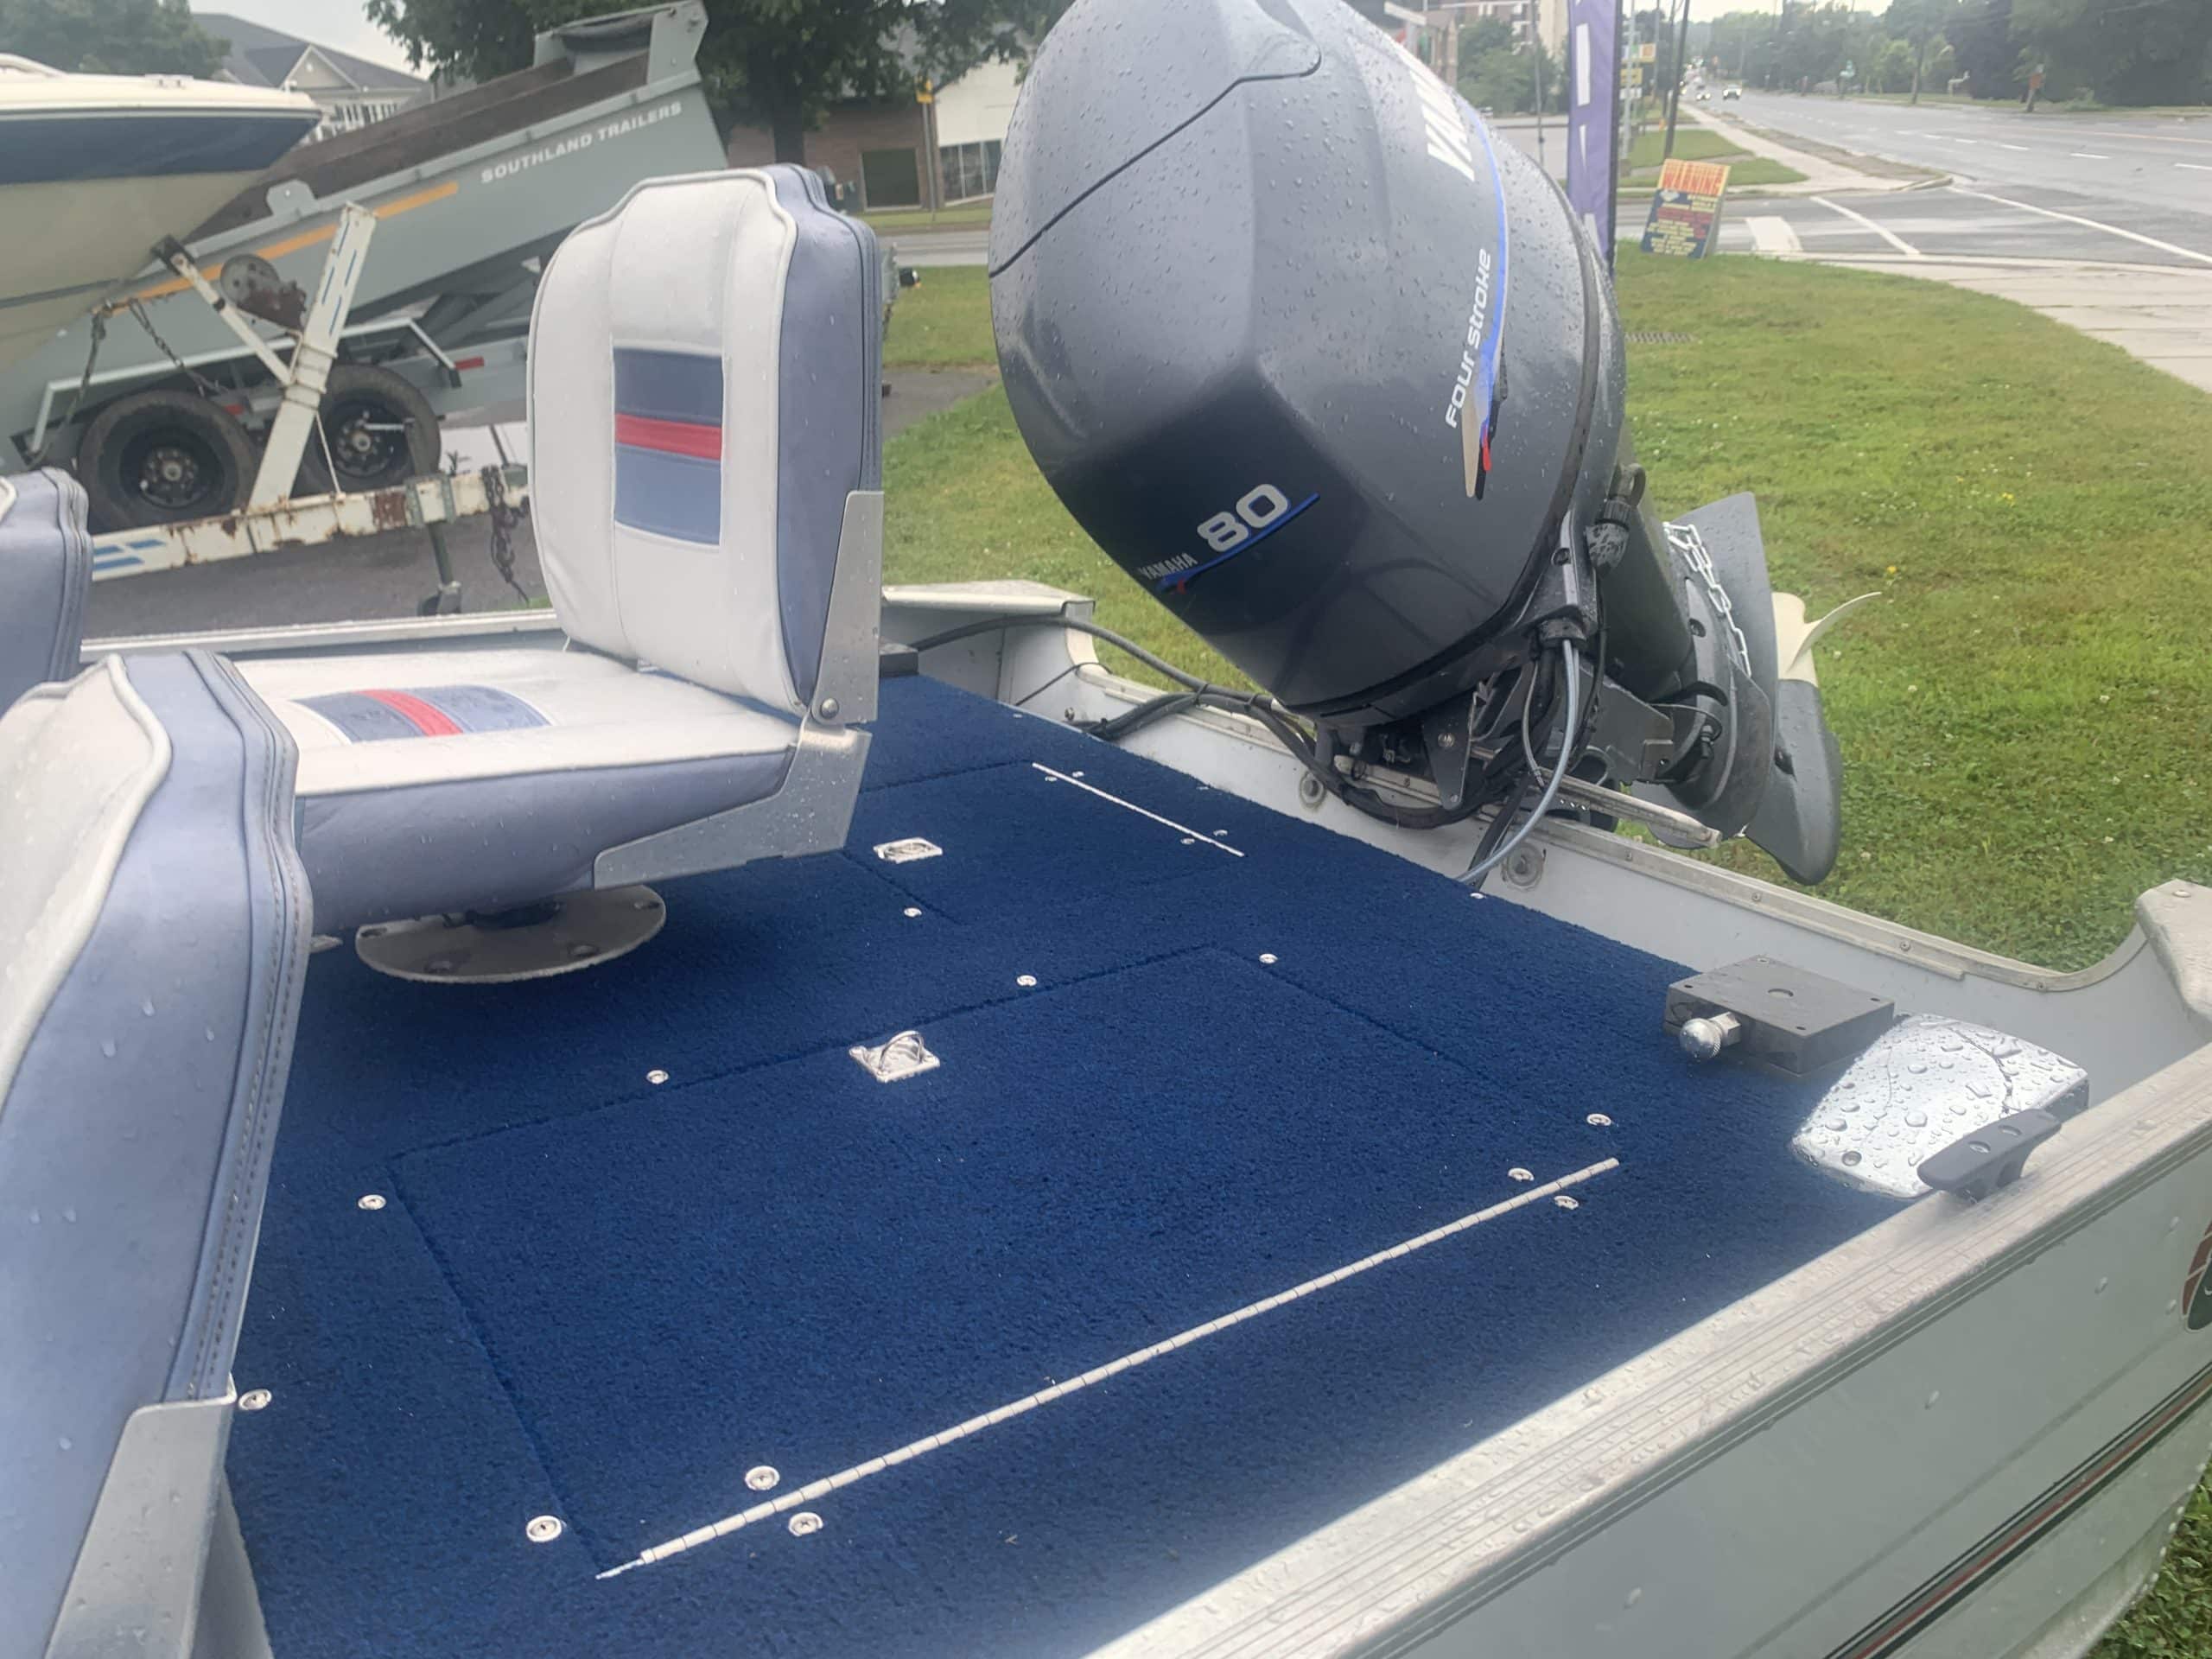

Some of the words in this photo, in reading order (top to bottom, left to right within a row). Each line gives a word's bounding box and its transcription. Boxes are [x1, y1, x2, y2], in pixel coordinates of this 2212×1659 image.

[480, 133, 594, 184] SOUTHLAND
[597, 100, 683, 142] TRAILERS
[1197, 484, 1289, 552] 80
[1137, 552, 1198, 580] YAMAHA
